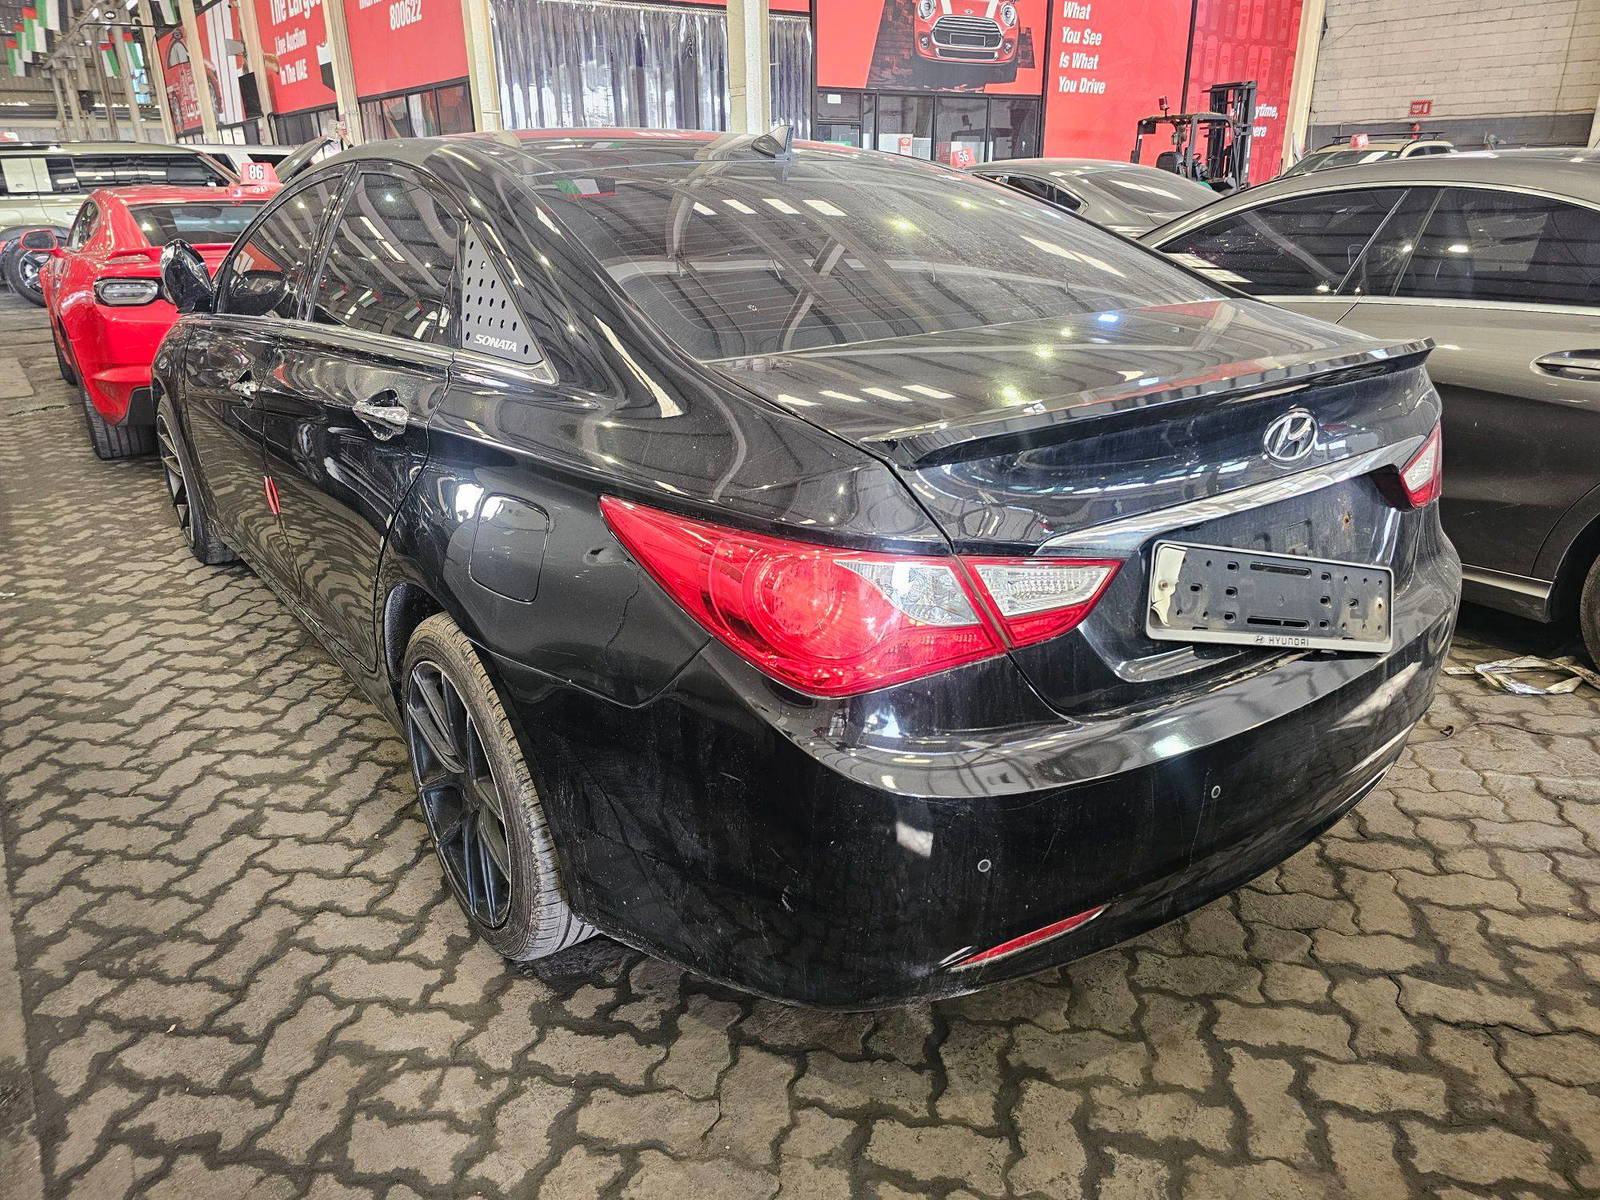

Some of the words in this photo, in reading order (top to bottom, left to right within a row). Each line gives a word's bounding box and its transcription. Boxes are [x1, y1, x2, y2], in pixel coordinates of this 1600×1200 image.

[389, 0, 423, 31] 800622
[1063, 1, 1091, 20] What
[1062, 26, 1081, 44] You
[1082, 28, 1102, 46] See
[1059, 51, 1070, 68] Is
[1071, 52, 1099, 70] What
[1058, 75, 1078, 93] You
[1079, 77, 1106, 95] Drive
[1254, 103, 1278, 120] ytime,
[248, 164, 264, 180] 86
[473, 334, 518, 353] SONATA
[1268, 635, 1310, 647] HYUNDAI
